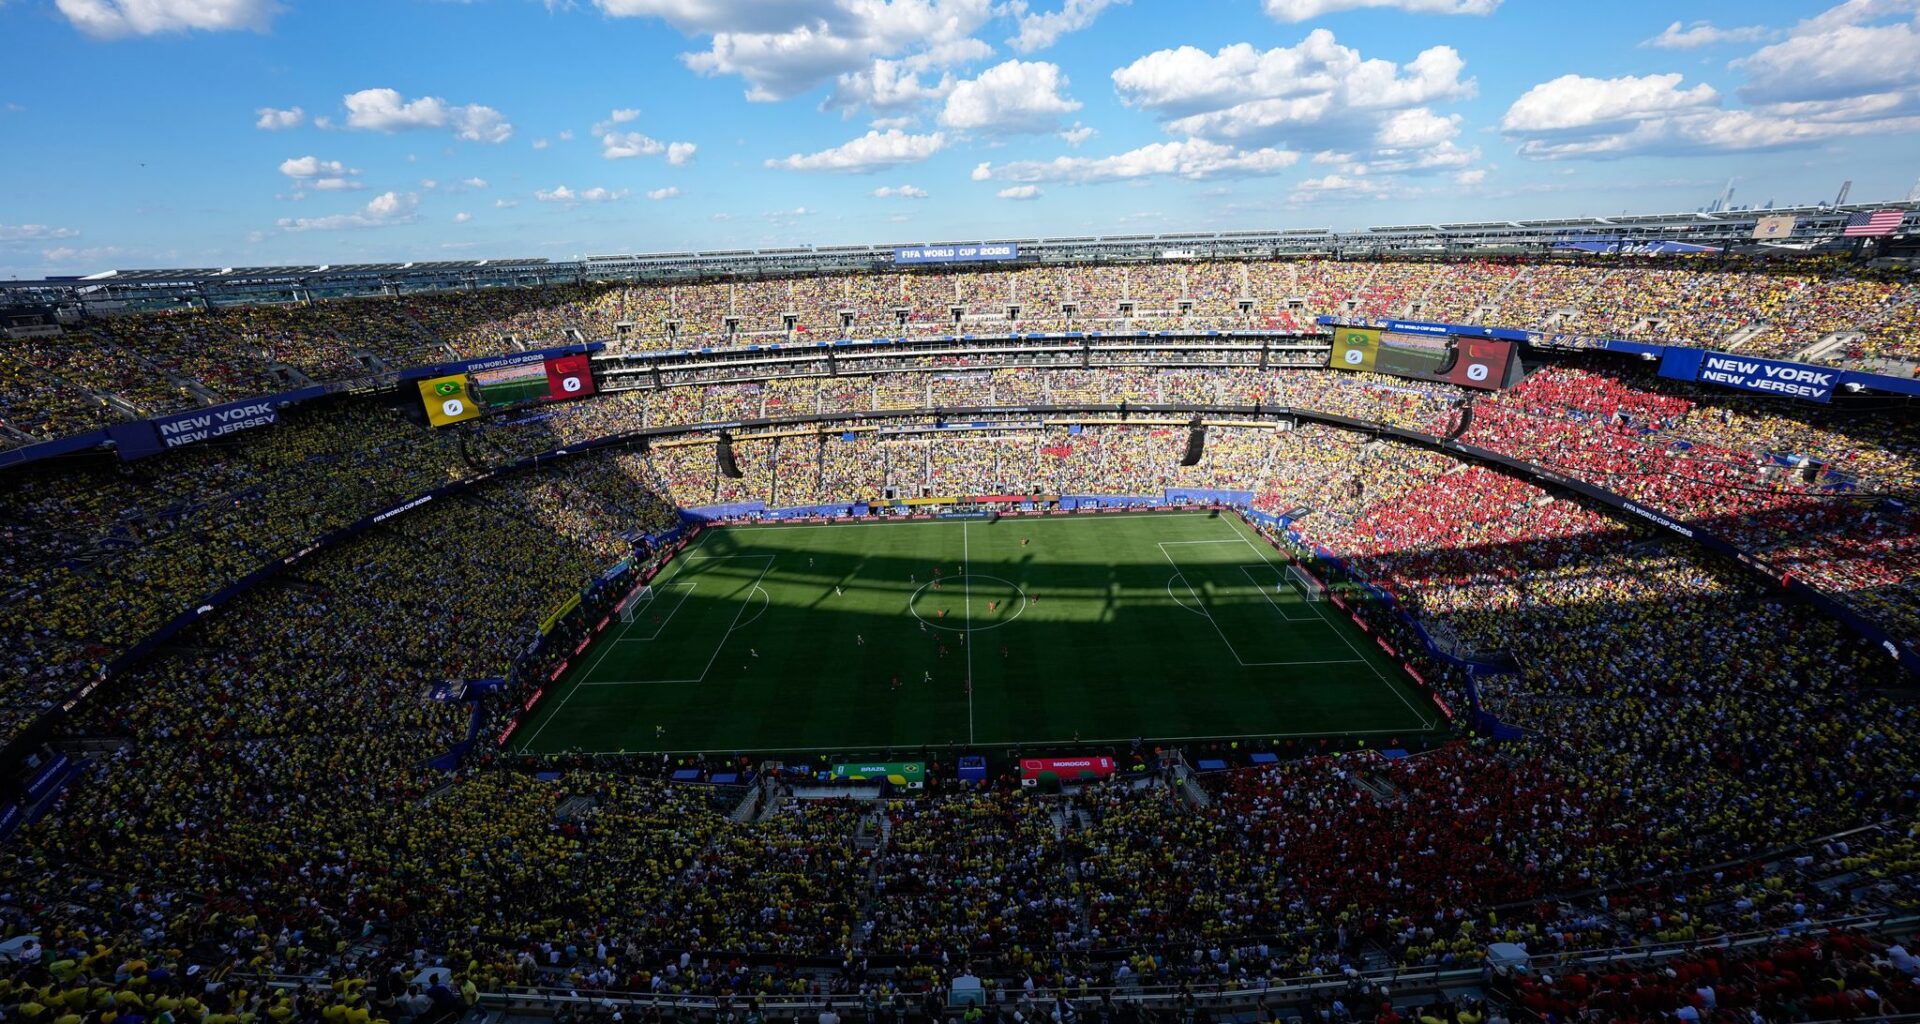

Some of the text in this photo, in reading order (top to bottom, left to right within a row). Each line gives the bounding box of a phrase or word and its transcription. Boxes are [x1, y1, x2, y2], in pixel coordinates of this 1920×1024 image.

[902, 247, 1010, 258] FIFA WORLD CUP 2026
[468, 364, 484, 372] FIFA
[483, 360, 508, 369] WORLD
[522, 354, 544, 362] 2026
[1707, 357, 1833, 386] NEW YORK
[1702, 370, 1826, 398] NEW JERSEY
[160, 402, 273, 436] NEW YORK
[166, 414, 275, 448] NEW JERSEY
[373, 495, 432, 523] FIFA WORLD CUP 2026
[1622, 502, 1693, 537] FIFA WORLD CUP 2026
